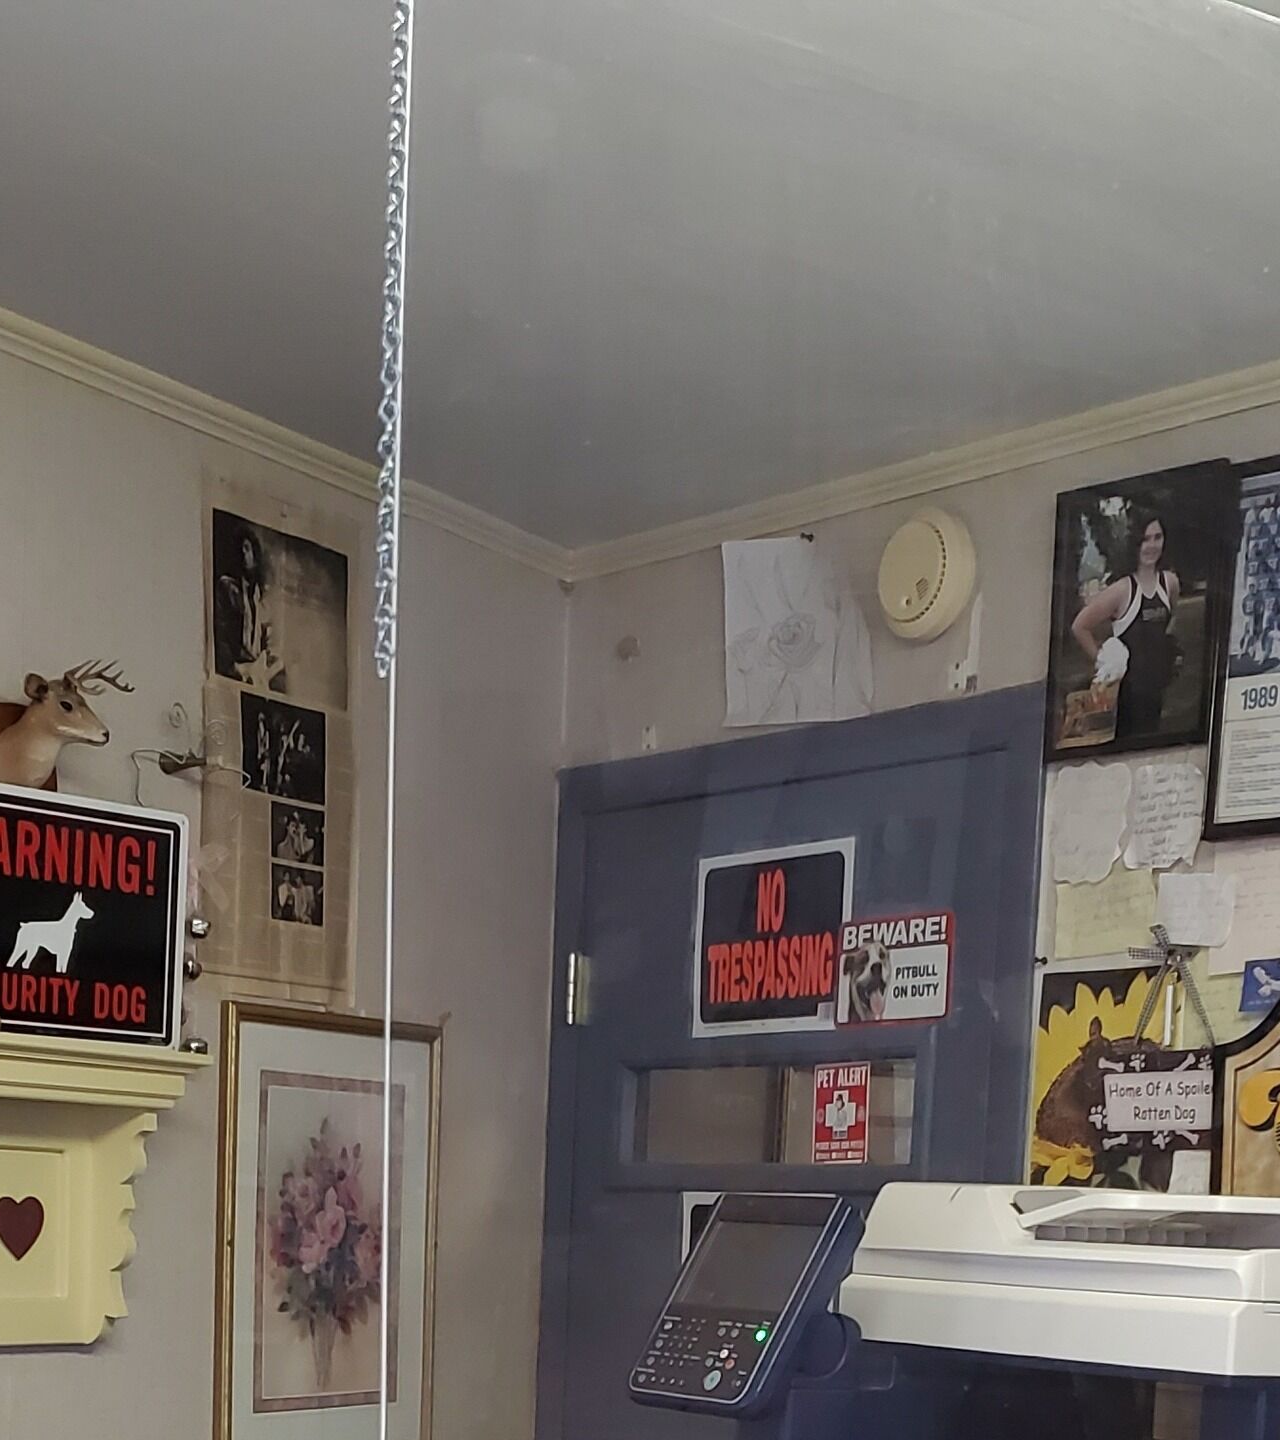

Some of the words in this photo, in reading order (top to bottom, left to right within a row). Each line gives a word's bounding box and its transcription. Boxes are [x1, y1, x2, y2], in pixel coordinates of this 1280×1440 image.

[1240, 684, 1278, 711] 1989
[756, 867, 786, 935] NO
[842, 914, 948, 951] BEWARE!
[707, 931, 835, 1005] TRESPASSING
[895, 964, 939, 981] PITBULL
[893, 984, 908, 999] ON
[910, 981, 941, 998] DUTY
[94, 982, 146, 1024] DOG
[817, 1069, 835, 1088] PET
[837, 1066, 867, 1087] ALERT
[1109, 1081, 1143, 1098] Home
[1145, 1079, 1161, 1096] Of
[1133, 1105, 1171, 1122] Rotten
[1173, 1105, 1196, 1124] Dog
